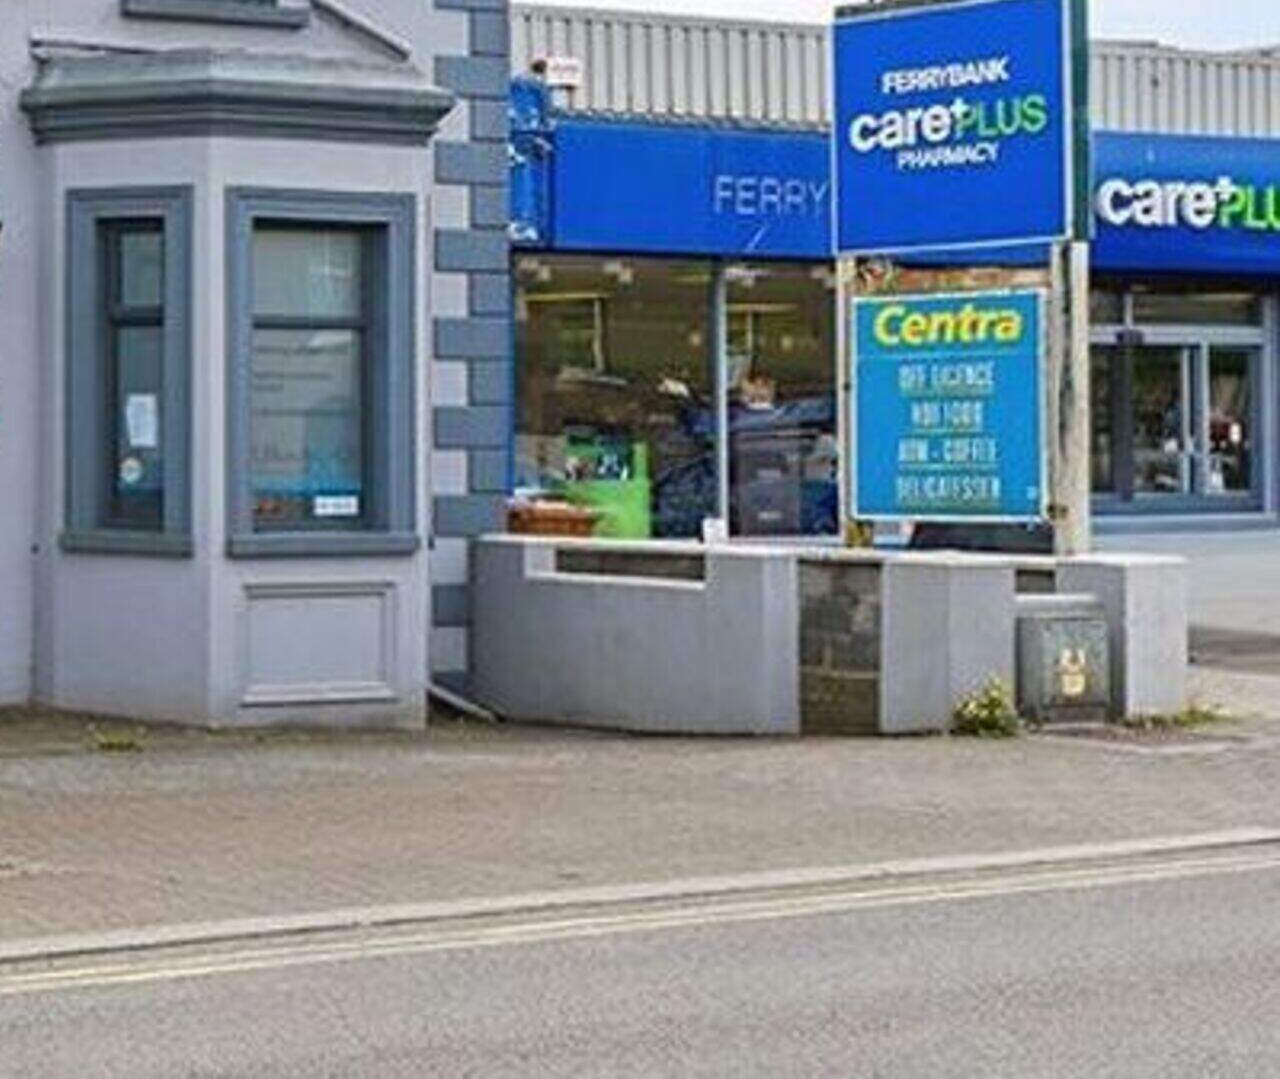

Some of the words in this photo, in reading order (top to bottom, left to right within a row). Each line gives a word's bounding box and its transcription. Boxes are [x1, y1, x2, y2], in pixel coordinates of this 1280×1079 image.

[882, 56, 1009, 93] FERRYBANK
[898, 142, 998, 170] PHARMACY
[715, 174, 827, 215] FERRY
[873, 305, 1022, 345] Centra
